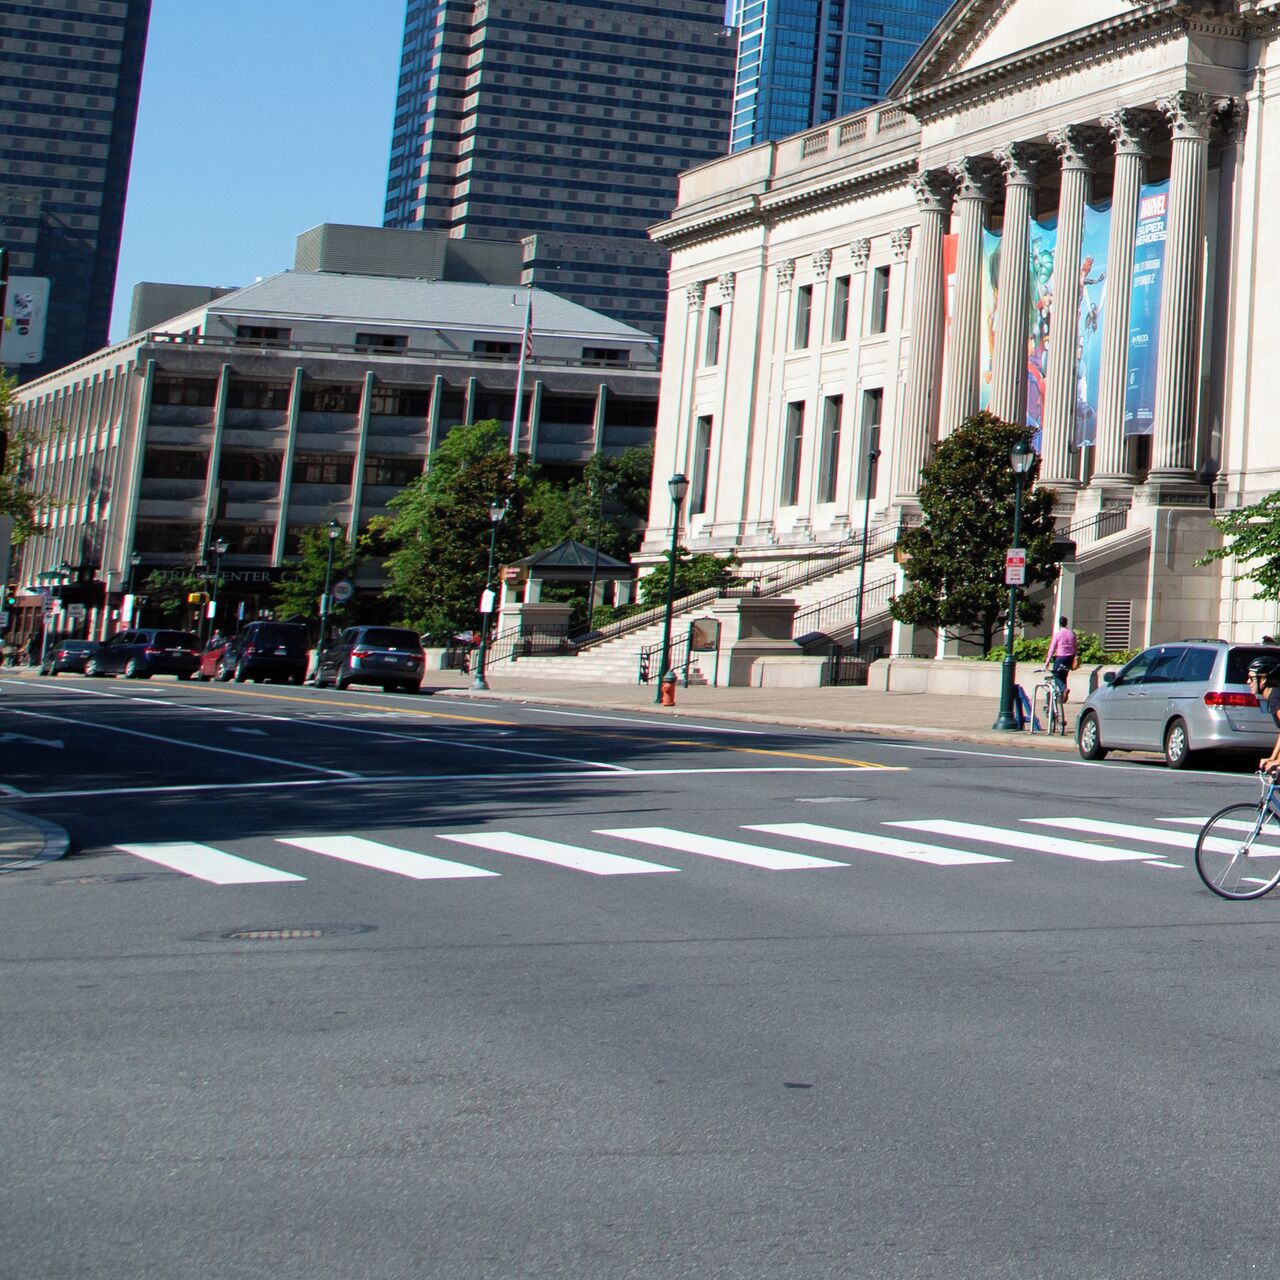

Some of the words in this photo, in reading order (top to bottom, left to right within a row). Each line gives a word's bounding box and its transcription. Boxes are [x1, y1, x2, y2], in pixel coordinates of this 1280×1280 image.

[1140, 195, 1166, 219] MARVEL
[1137, 221, 1164, 237] SUPER
[210, 570, 270, 582] ENTER
